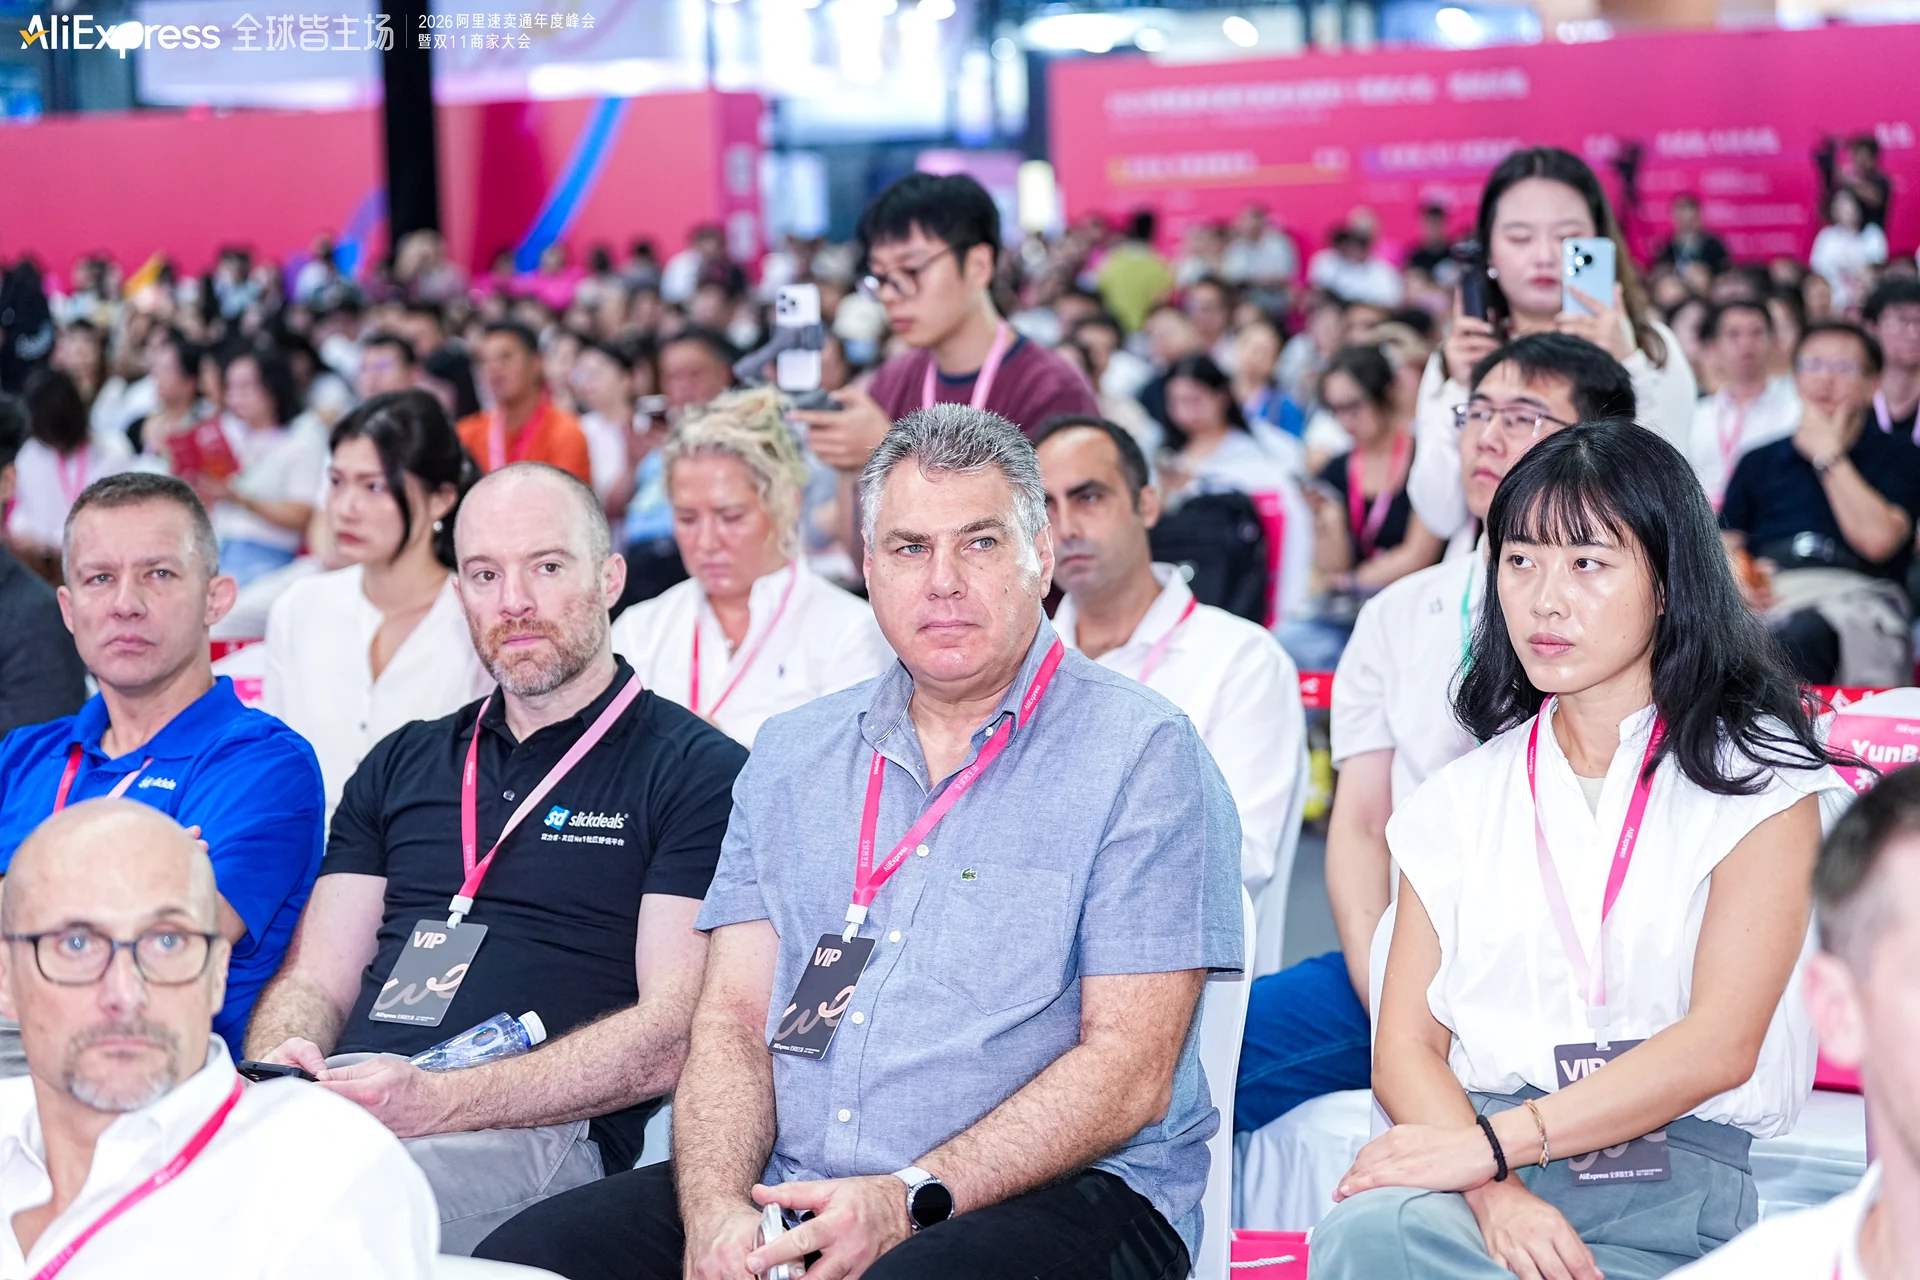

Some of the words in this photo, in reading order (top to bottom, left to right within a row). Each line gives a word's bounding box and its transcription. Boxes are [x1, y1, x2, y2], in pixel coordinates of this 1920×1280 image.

[1851, 739, 1920, 763] YunB
[568, 811, 625, 829] slickdeals
[1619, 826, 1635, 859] AliExpress
[883, 846, 908, 872] AliExpress
[413, 931, 447, 949] VIP
[813, 947, 842, 967] VIP
[1559, 1057, 1608, 1082] VIP
